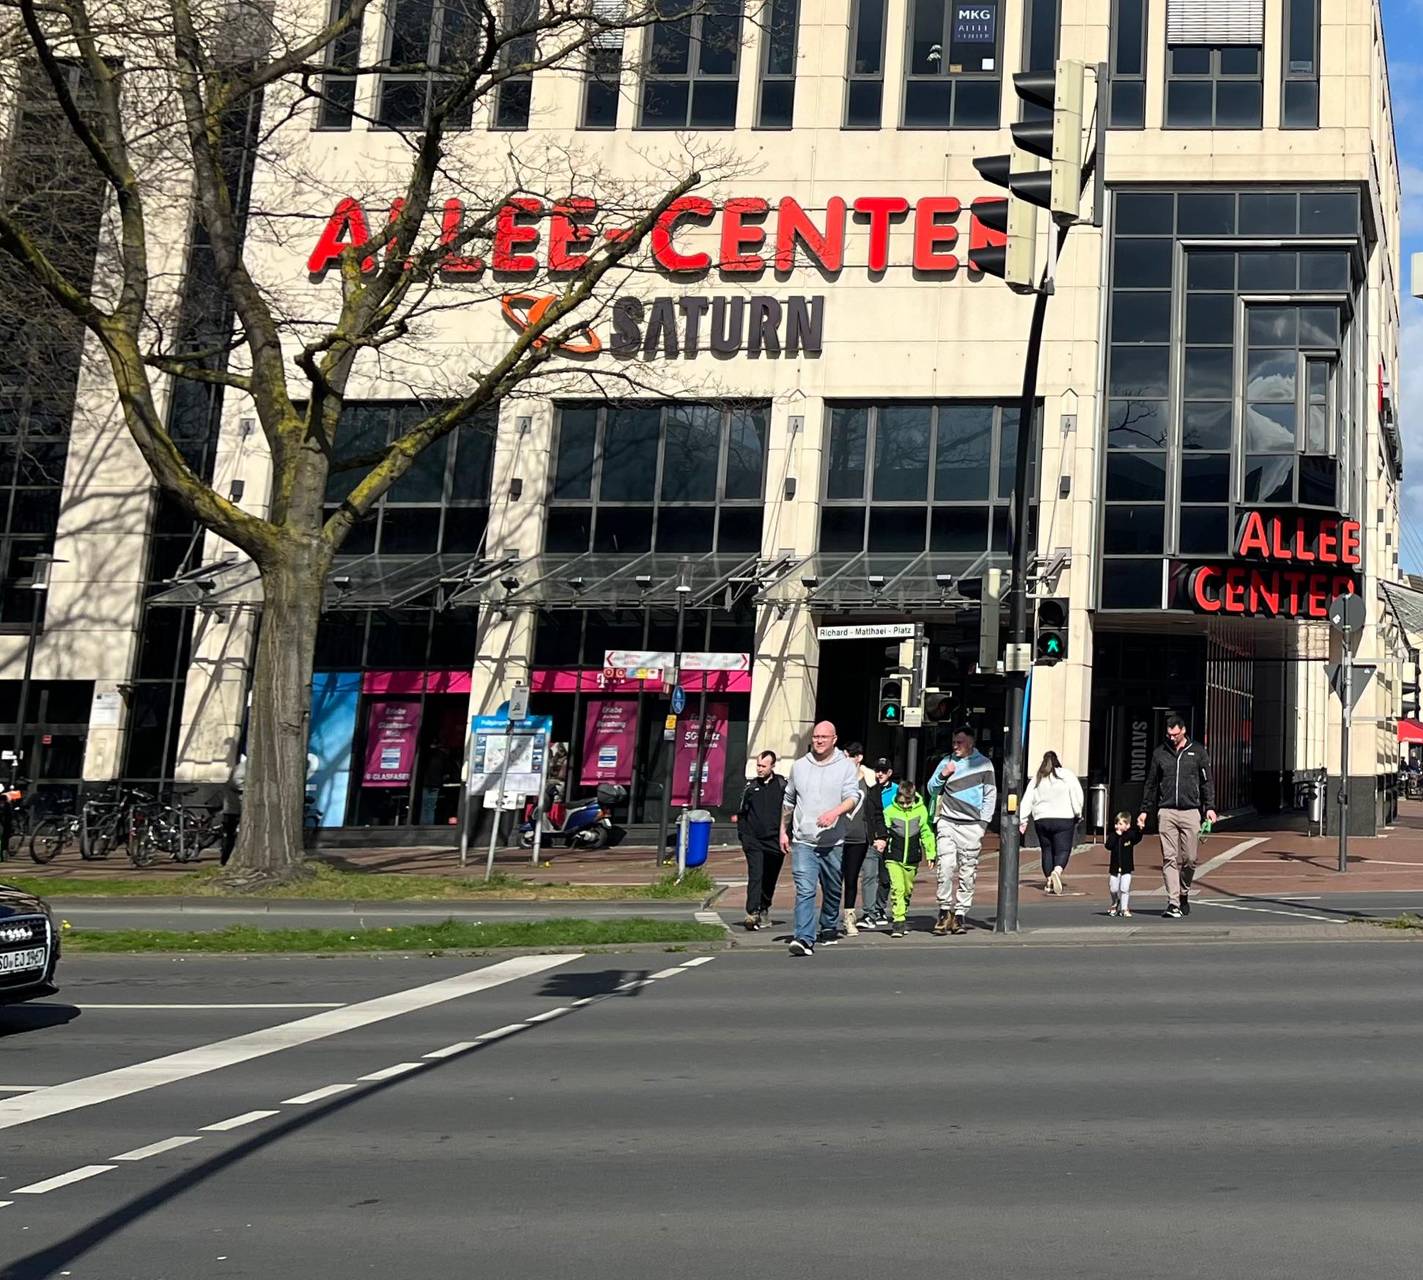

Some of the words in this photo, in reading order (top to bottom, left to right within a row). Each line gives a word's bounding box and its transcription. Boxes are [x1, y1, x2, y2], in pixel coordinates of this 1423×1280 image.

[958, 9, 991, 20] MKG
[306, 195, 1008, 273] ALEE-CENTE
[610, 295, 824, 361] SATURN
[1239, 511, 1361, 564] ALLEE
[819, 628, 848, 637] Richard
[893, 626, 912, 634] Platz
[1130, 720, 1148, 781] SATURN
